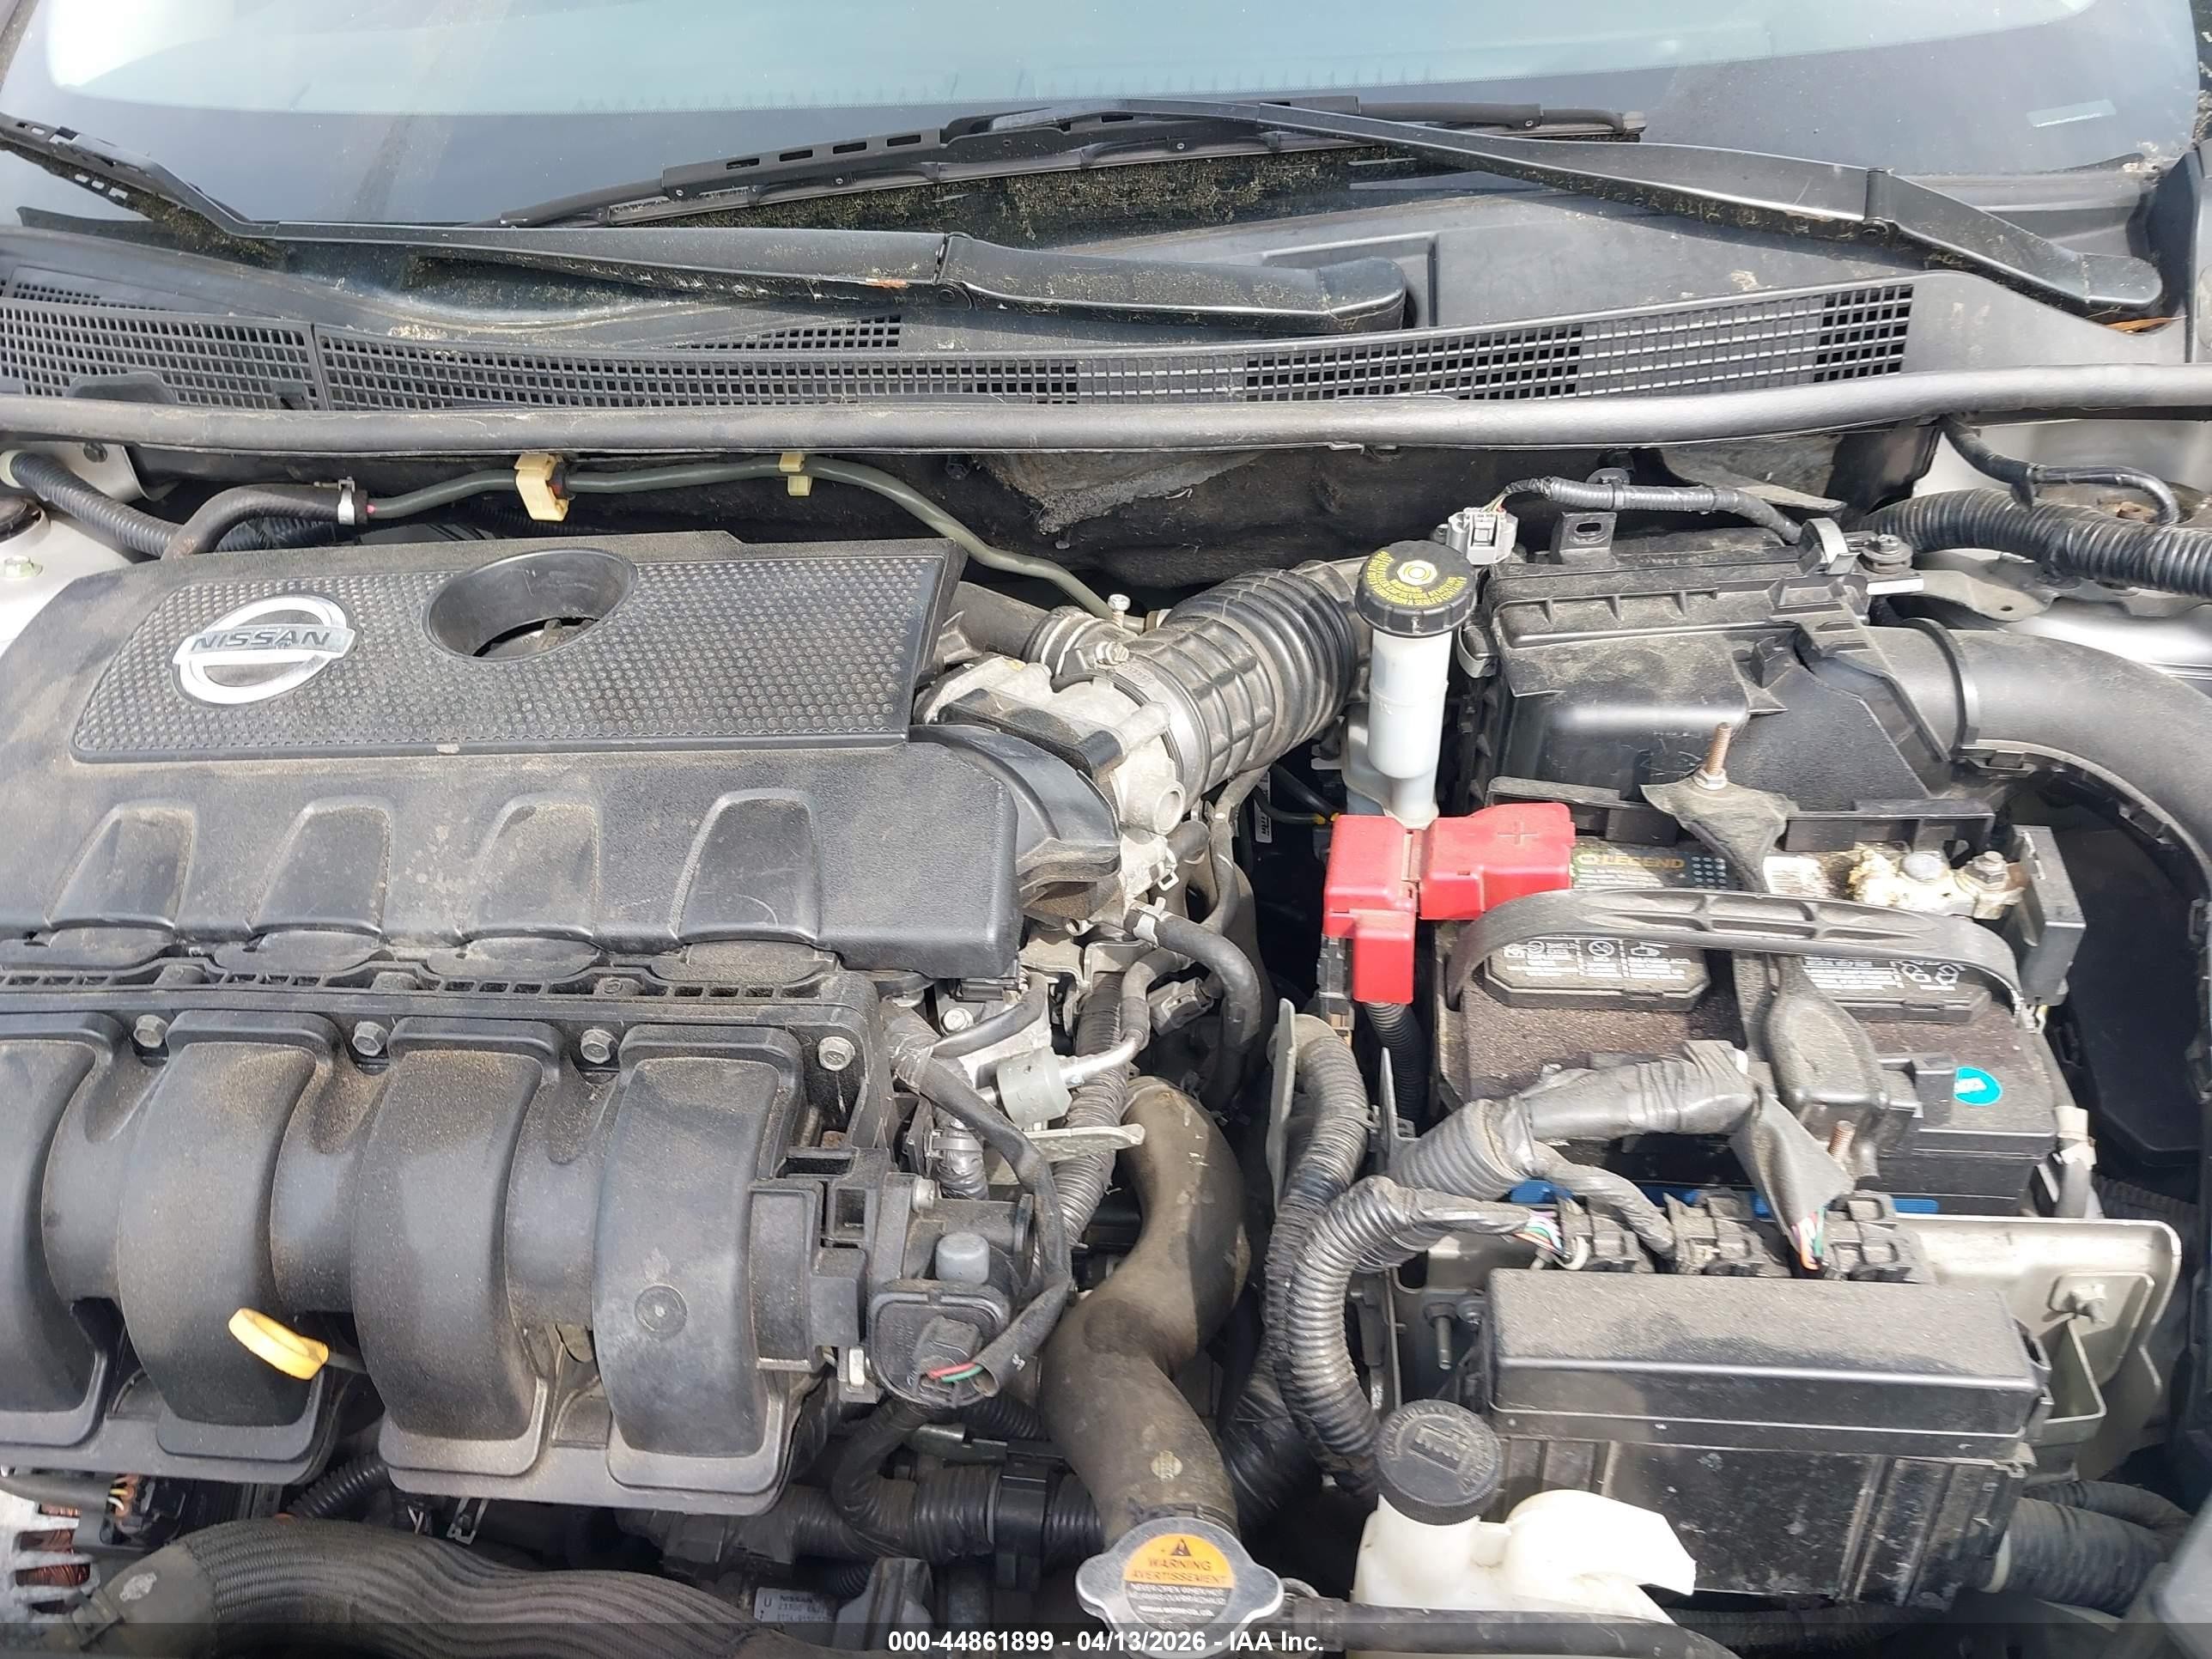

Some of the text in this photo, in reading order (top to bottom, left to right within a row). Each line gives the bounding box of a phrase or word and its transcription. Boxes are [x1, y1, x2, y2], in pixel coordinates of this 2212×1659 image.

[191, 630, 331, 651] NISSAN
[1601, 854, 1686, 870] LEGEND
[1148, 1559, 1211, 1571] WARNING
[1133, 1571, 1226, 1583] AVERTISSEMENT
